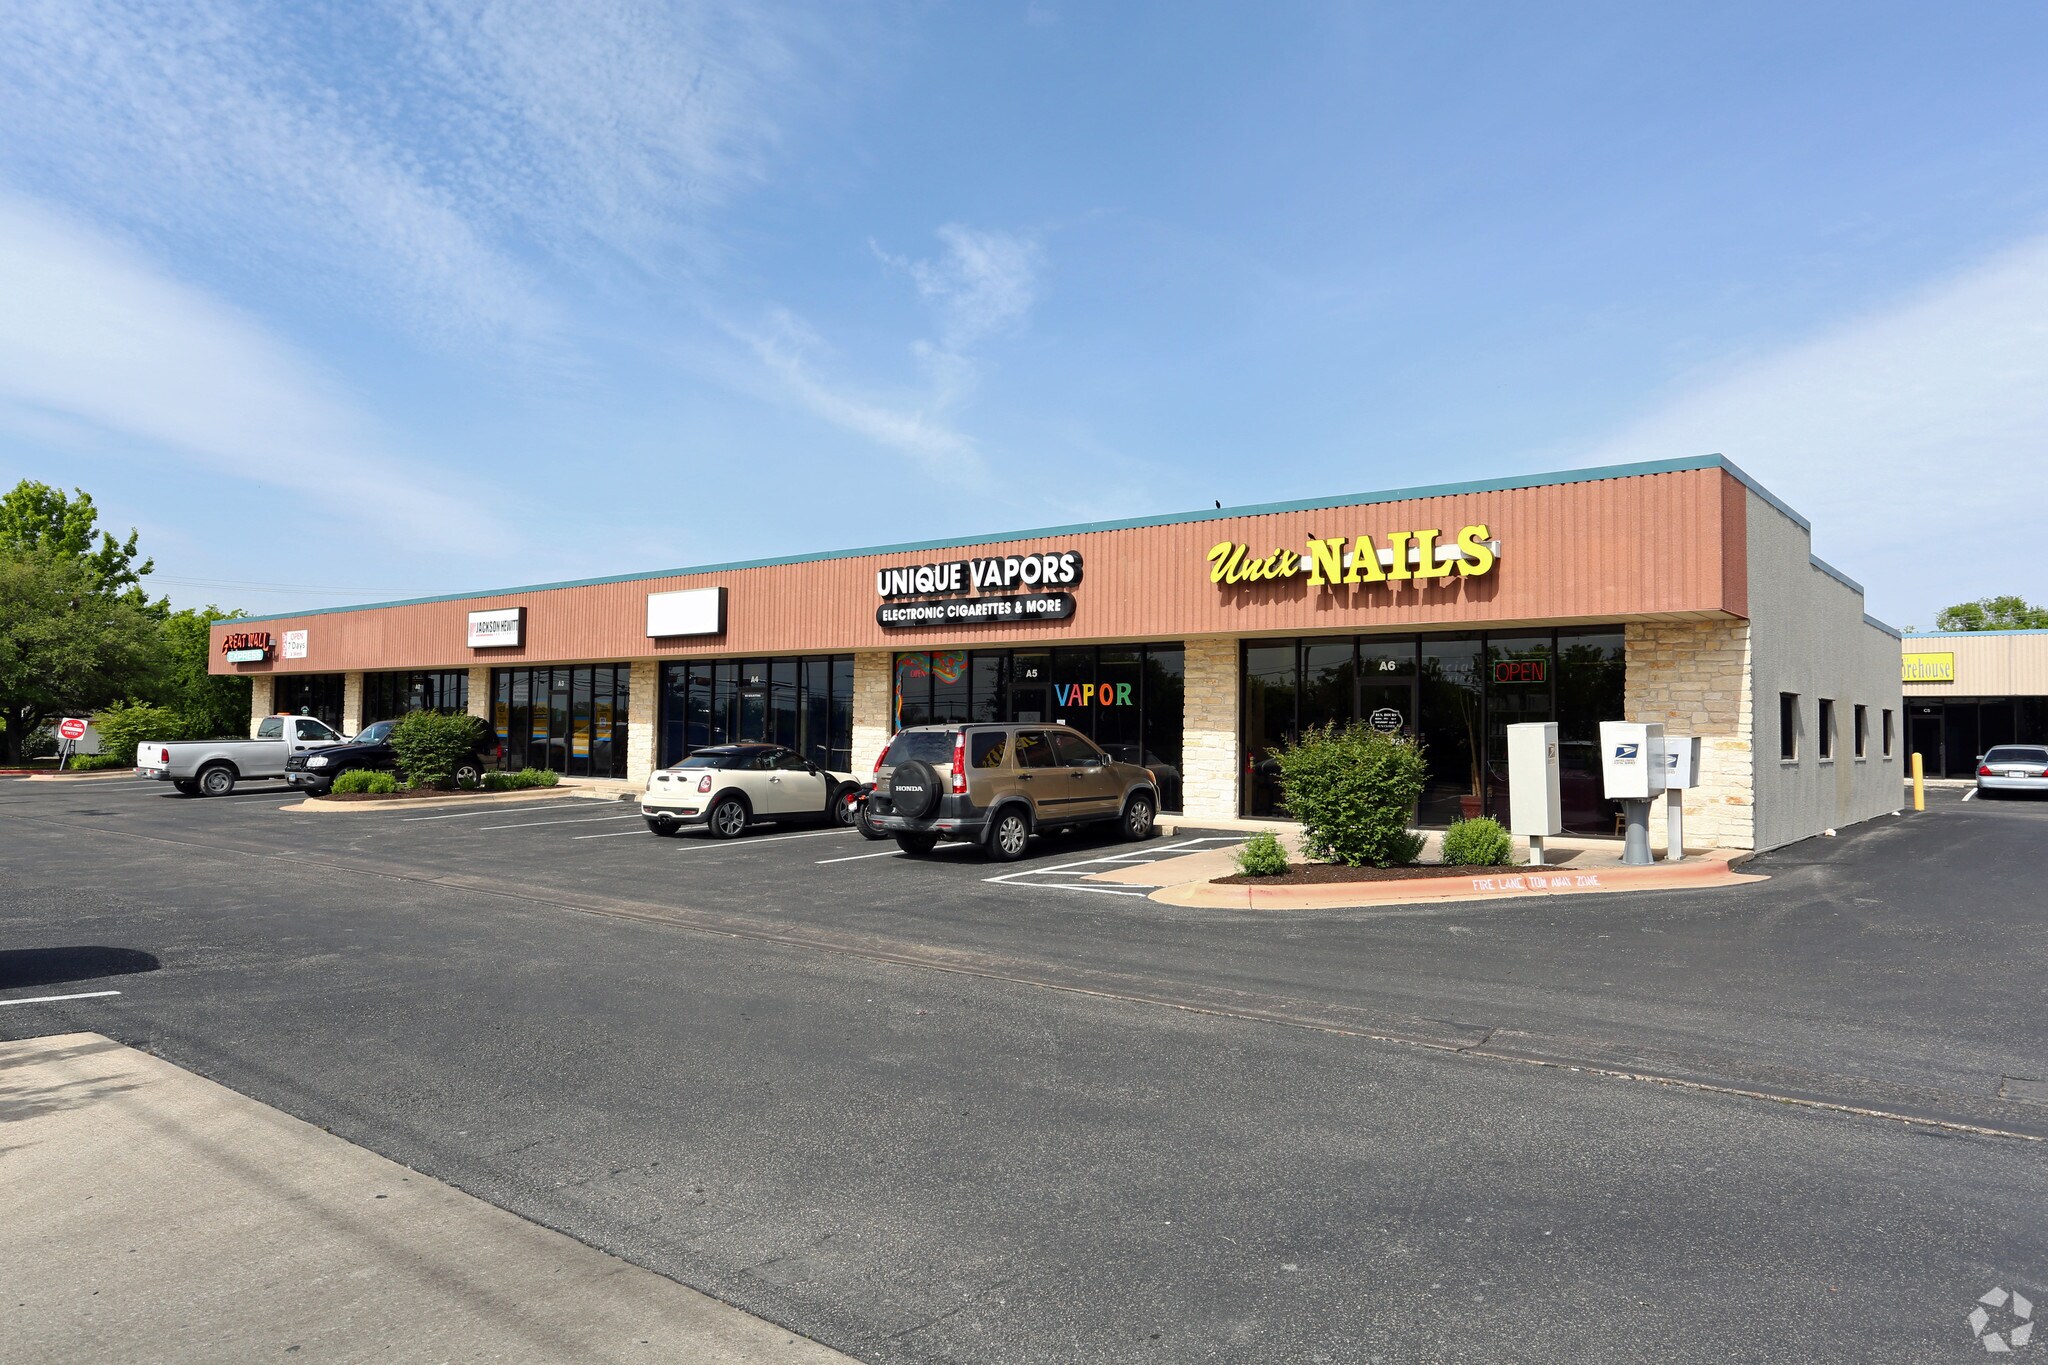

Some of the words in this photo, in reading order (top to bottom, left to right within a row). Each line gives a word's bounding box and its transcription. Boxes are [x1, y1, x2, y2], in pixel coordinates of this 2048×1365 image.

[1206, 541, 1301, 584] Unix
[1306, 524, 1494, 586] NAILS
[876, 563, 961, 596] UNIQUE
[969, 553, 1076, 588] VAPORS
[882, 607, 945, 622] ELECTRONIC
[947, 602, 1011, 618] CIGARETTES
[1015, 602, 1023, 614] &
[1026, 599, 1062, 613] MORE
[476, 620, 500, 633] JACKSON
[222, 634, 246, 655] GREAT
[247, 632, 269, 651] WALL
[291, 632, 304, 640] OPEN
[292, 641, 306, 650] Days
[228, 651, 263, 660] EXPRESS
[1026, 669, 1038, 678] A5
[1379, 660, 1396, 671] A6
[1496, 662, 1543, 682] OPEN
[1054, 683, 1133, 707] VAPOR
[1472, 880, 1495, 891] FIRE
[1499, 878, 1525, 890] LANE
[1529, 876, 1547, 888] TOW
[1575, 875, 1601, 886] ZONE
